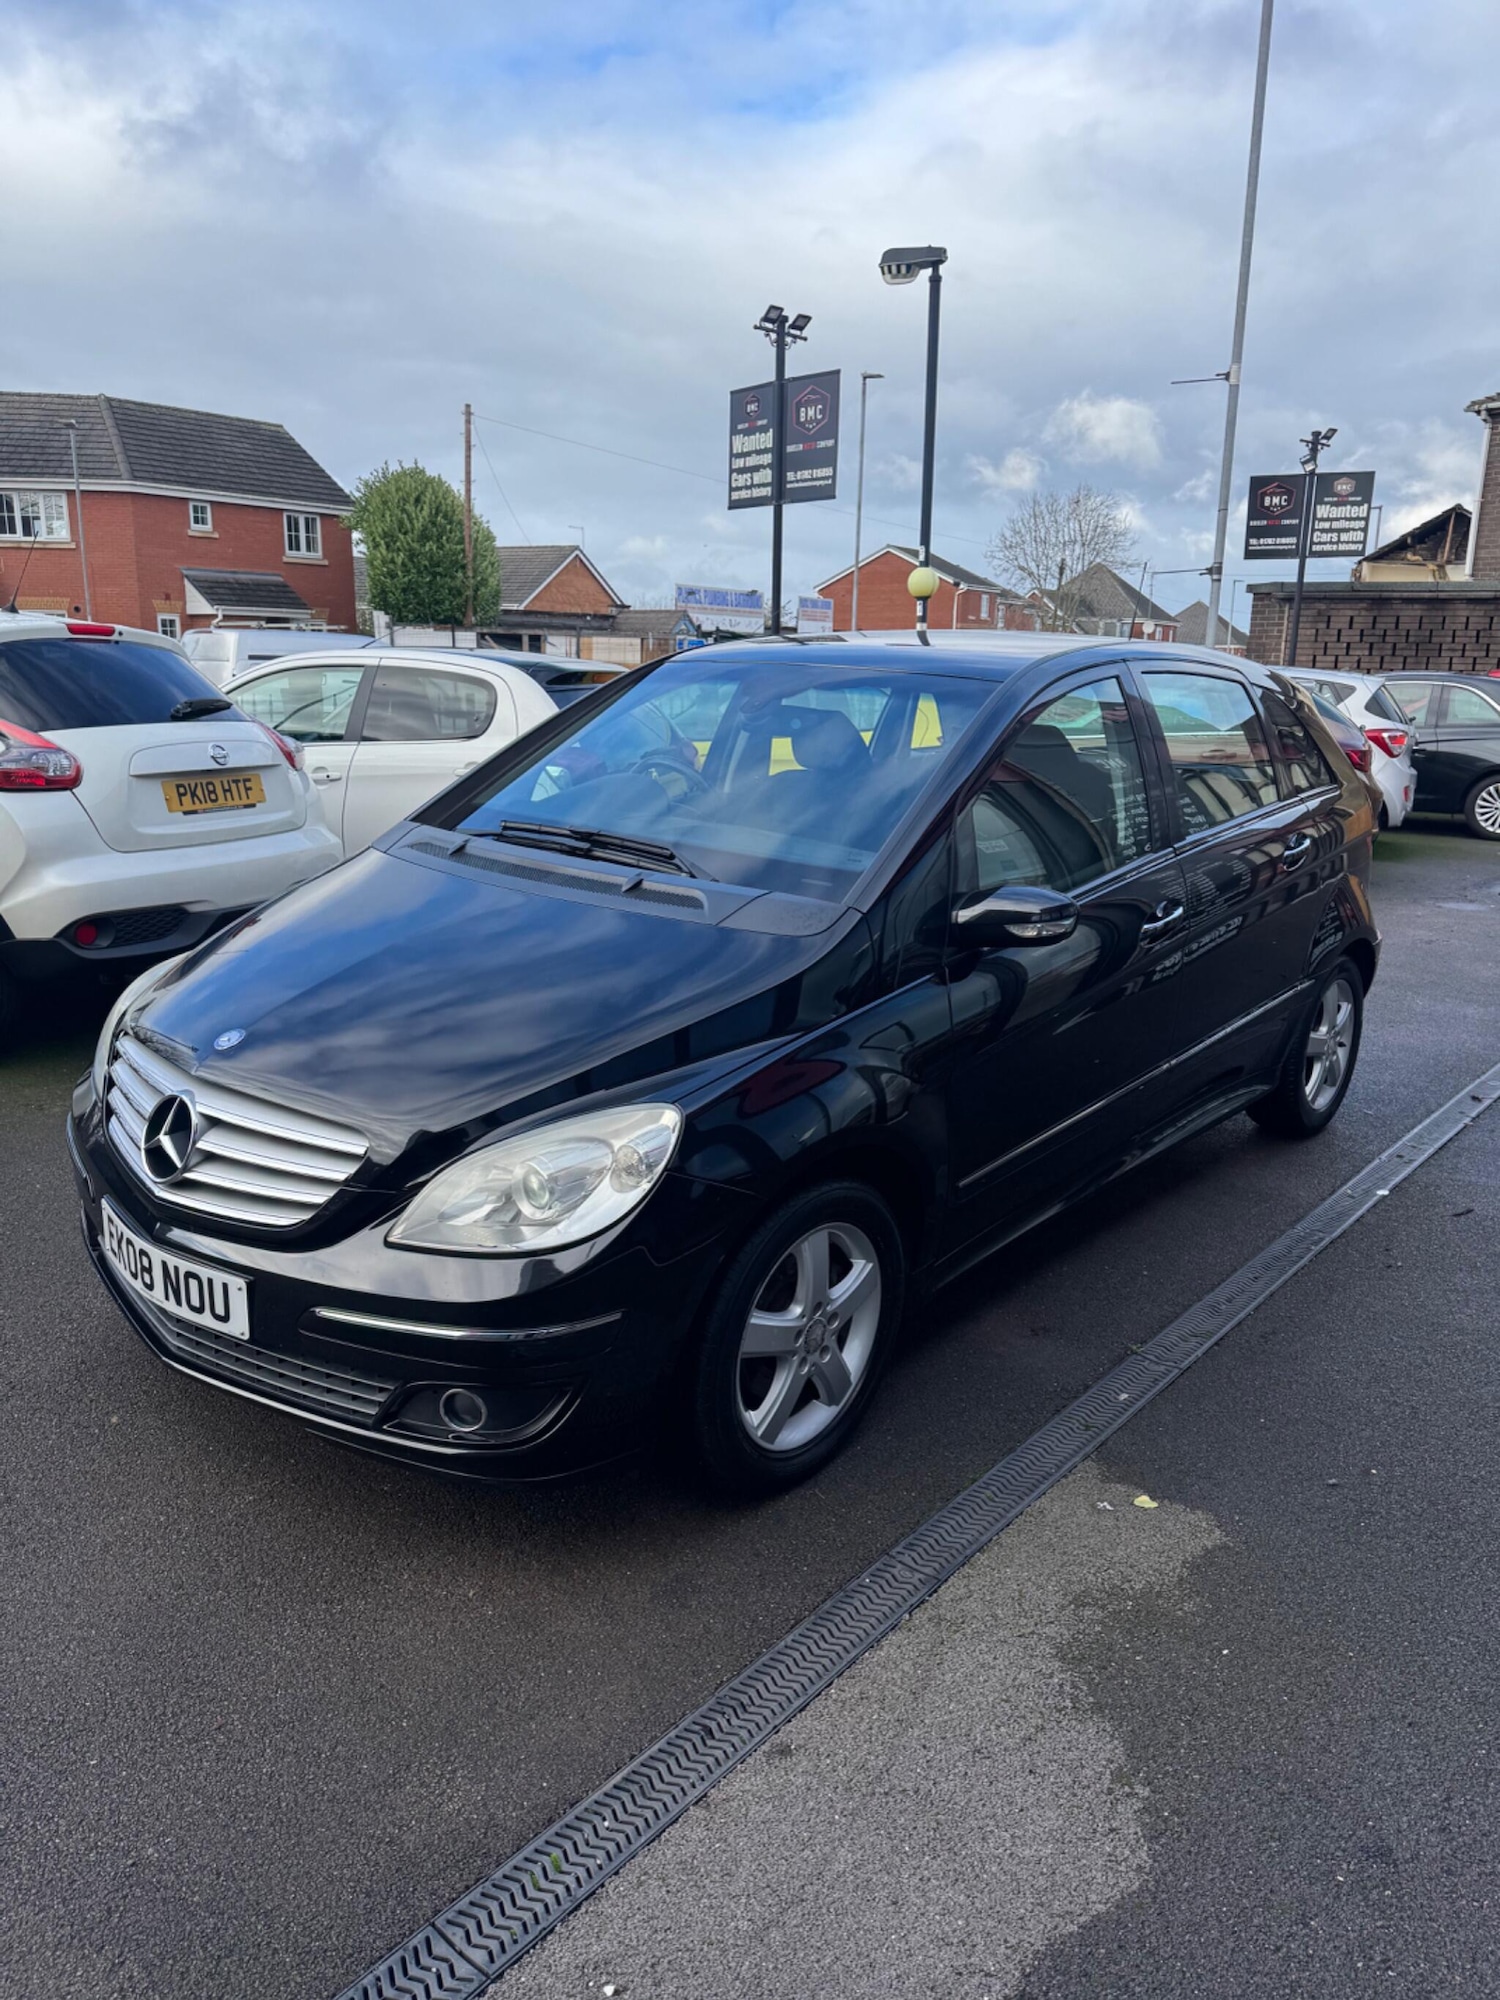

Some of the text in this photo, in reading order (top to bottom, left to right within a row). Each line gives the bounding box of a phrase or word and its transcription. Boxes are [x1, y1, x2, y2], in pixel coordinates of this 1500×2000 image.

[800, 404, 823, 422] BMC
[732, 428, 773, 454] Wanted
[731, 452, 772, 469] Low mileage
[731, 472, 752, 488] Cars
[752, 467, 773, 485] with
[731, 485, 772, 500] service history
[1264, 495, 1288, 507] BMC
[1316, 503, 1369, 518] Wanted
[1314, 519, 1366, 530] Low mileage
[1312, 530, 1365, 542] Cars with
[1312, 542, 1363, 552] service history
[175, 778, 253, 806] PK18 HTF
[107, 1215, 230, 1324] EK08 NOU
